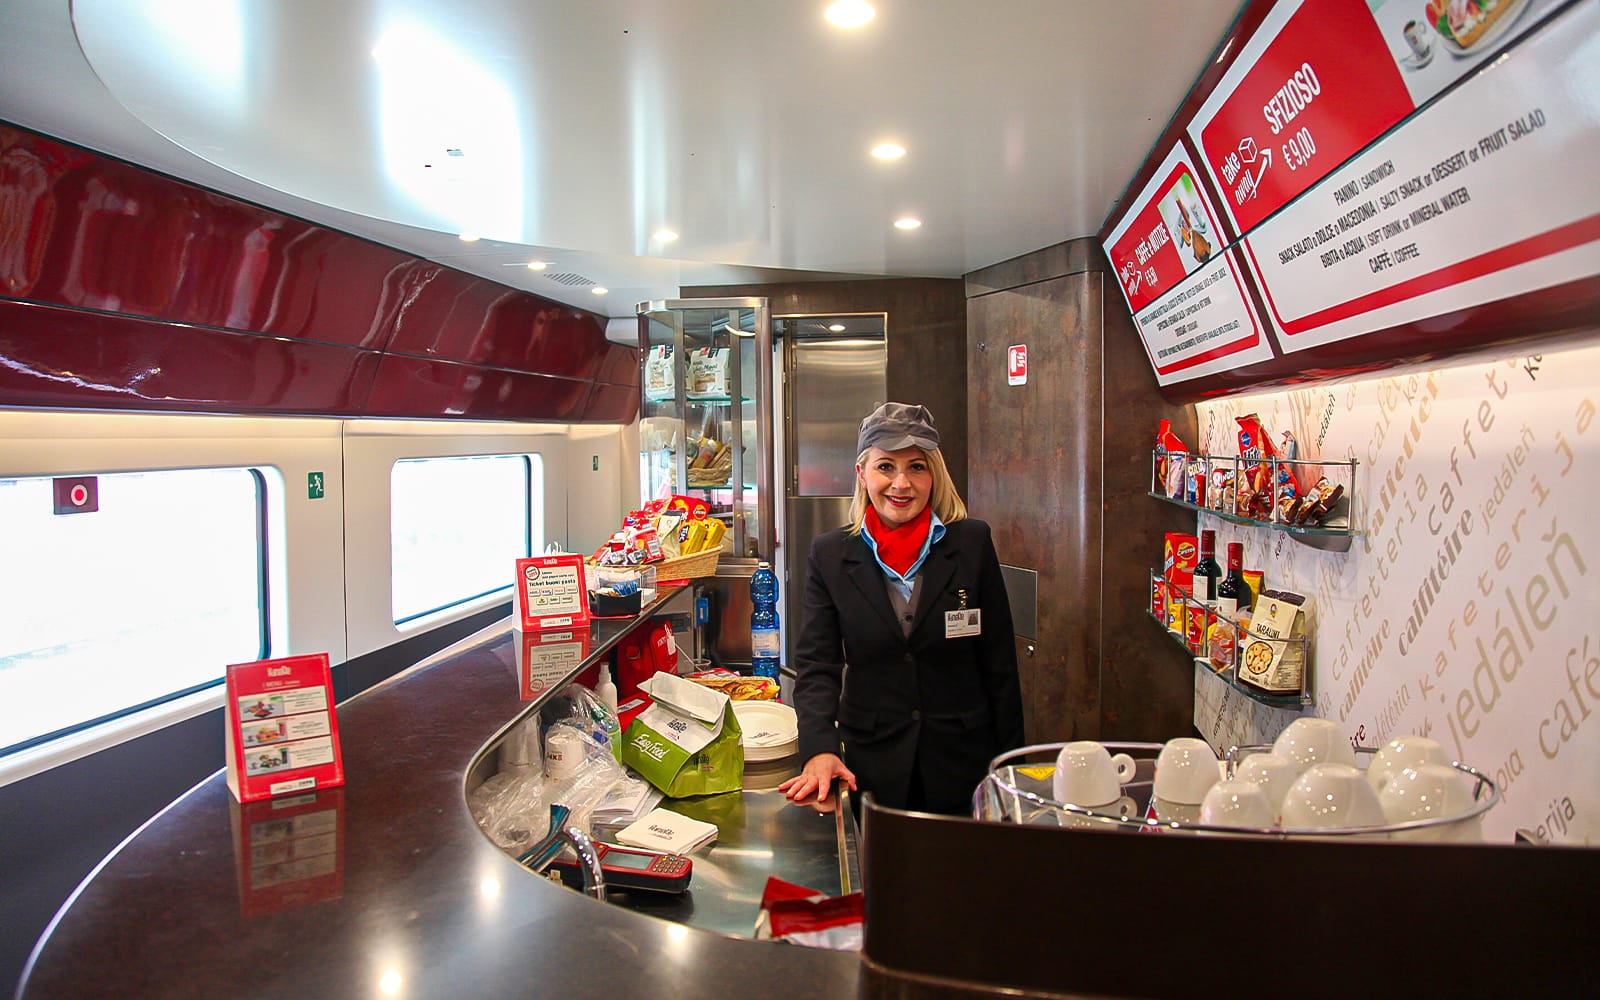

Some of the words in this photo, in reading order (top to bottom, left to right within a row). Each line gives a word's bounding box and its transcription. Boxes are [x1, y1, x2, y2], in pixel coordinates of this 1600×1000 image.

[1263, 62, 1320, 135] SFIZIOSO
[1220, 152, 1241, 186] take
[1282, 144, 1296, 171] €
[1289, 127, 1316, 167] 9,00
[1235, 169, 1257, 206] away
[1278, 247, 1297, 265] SNACK
[1293, 236, 1314, 257] SALATO
[1315, 224, 1336, 245] DOLCE
[1337, 200, 1378, 233] MACEDONIA
[1380, 190, 1401, 210] SALTY
[1400, 175, 1426, 200] SNACK
[1424, 173, 1433, 187] or
[1431, 150, 1469, 182] DESSERT
[1469, 147, 1480, 163] or
[1478, 128, 1508, 158] FRUIT
[1507, 108, 1547, 141] SALAD
[1334, 180, 1360, 206] PANINO
[1361, 160, 1396, 190] SANDWICH
[1320, 250, 1342, 269] BIBITA
[1342, 236, 1367, 258] ACQUA
[1368, 229, 1384, 247] SOFT
[1382, 220, 1405, 240] DRINK
[1402, 218, 1411, 231] or
[1408, 201, 1444, 227] MINERAL
[1439, 186, 1471, 212] WATER
[1368, 249, 1393, 274] CAFFÈ
[1395, 242, 1421, 264] COFFEE
[1316, 391, 1336, 457] jedáleň
[1479, 423, 1537, 534] jedáleň
[1440, 515, 1588, 764] jedáleň
